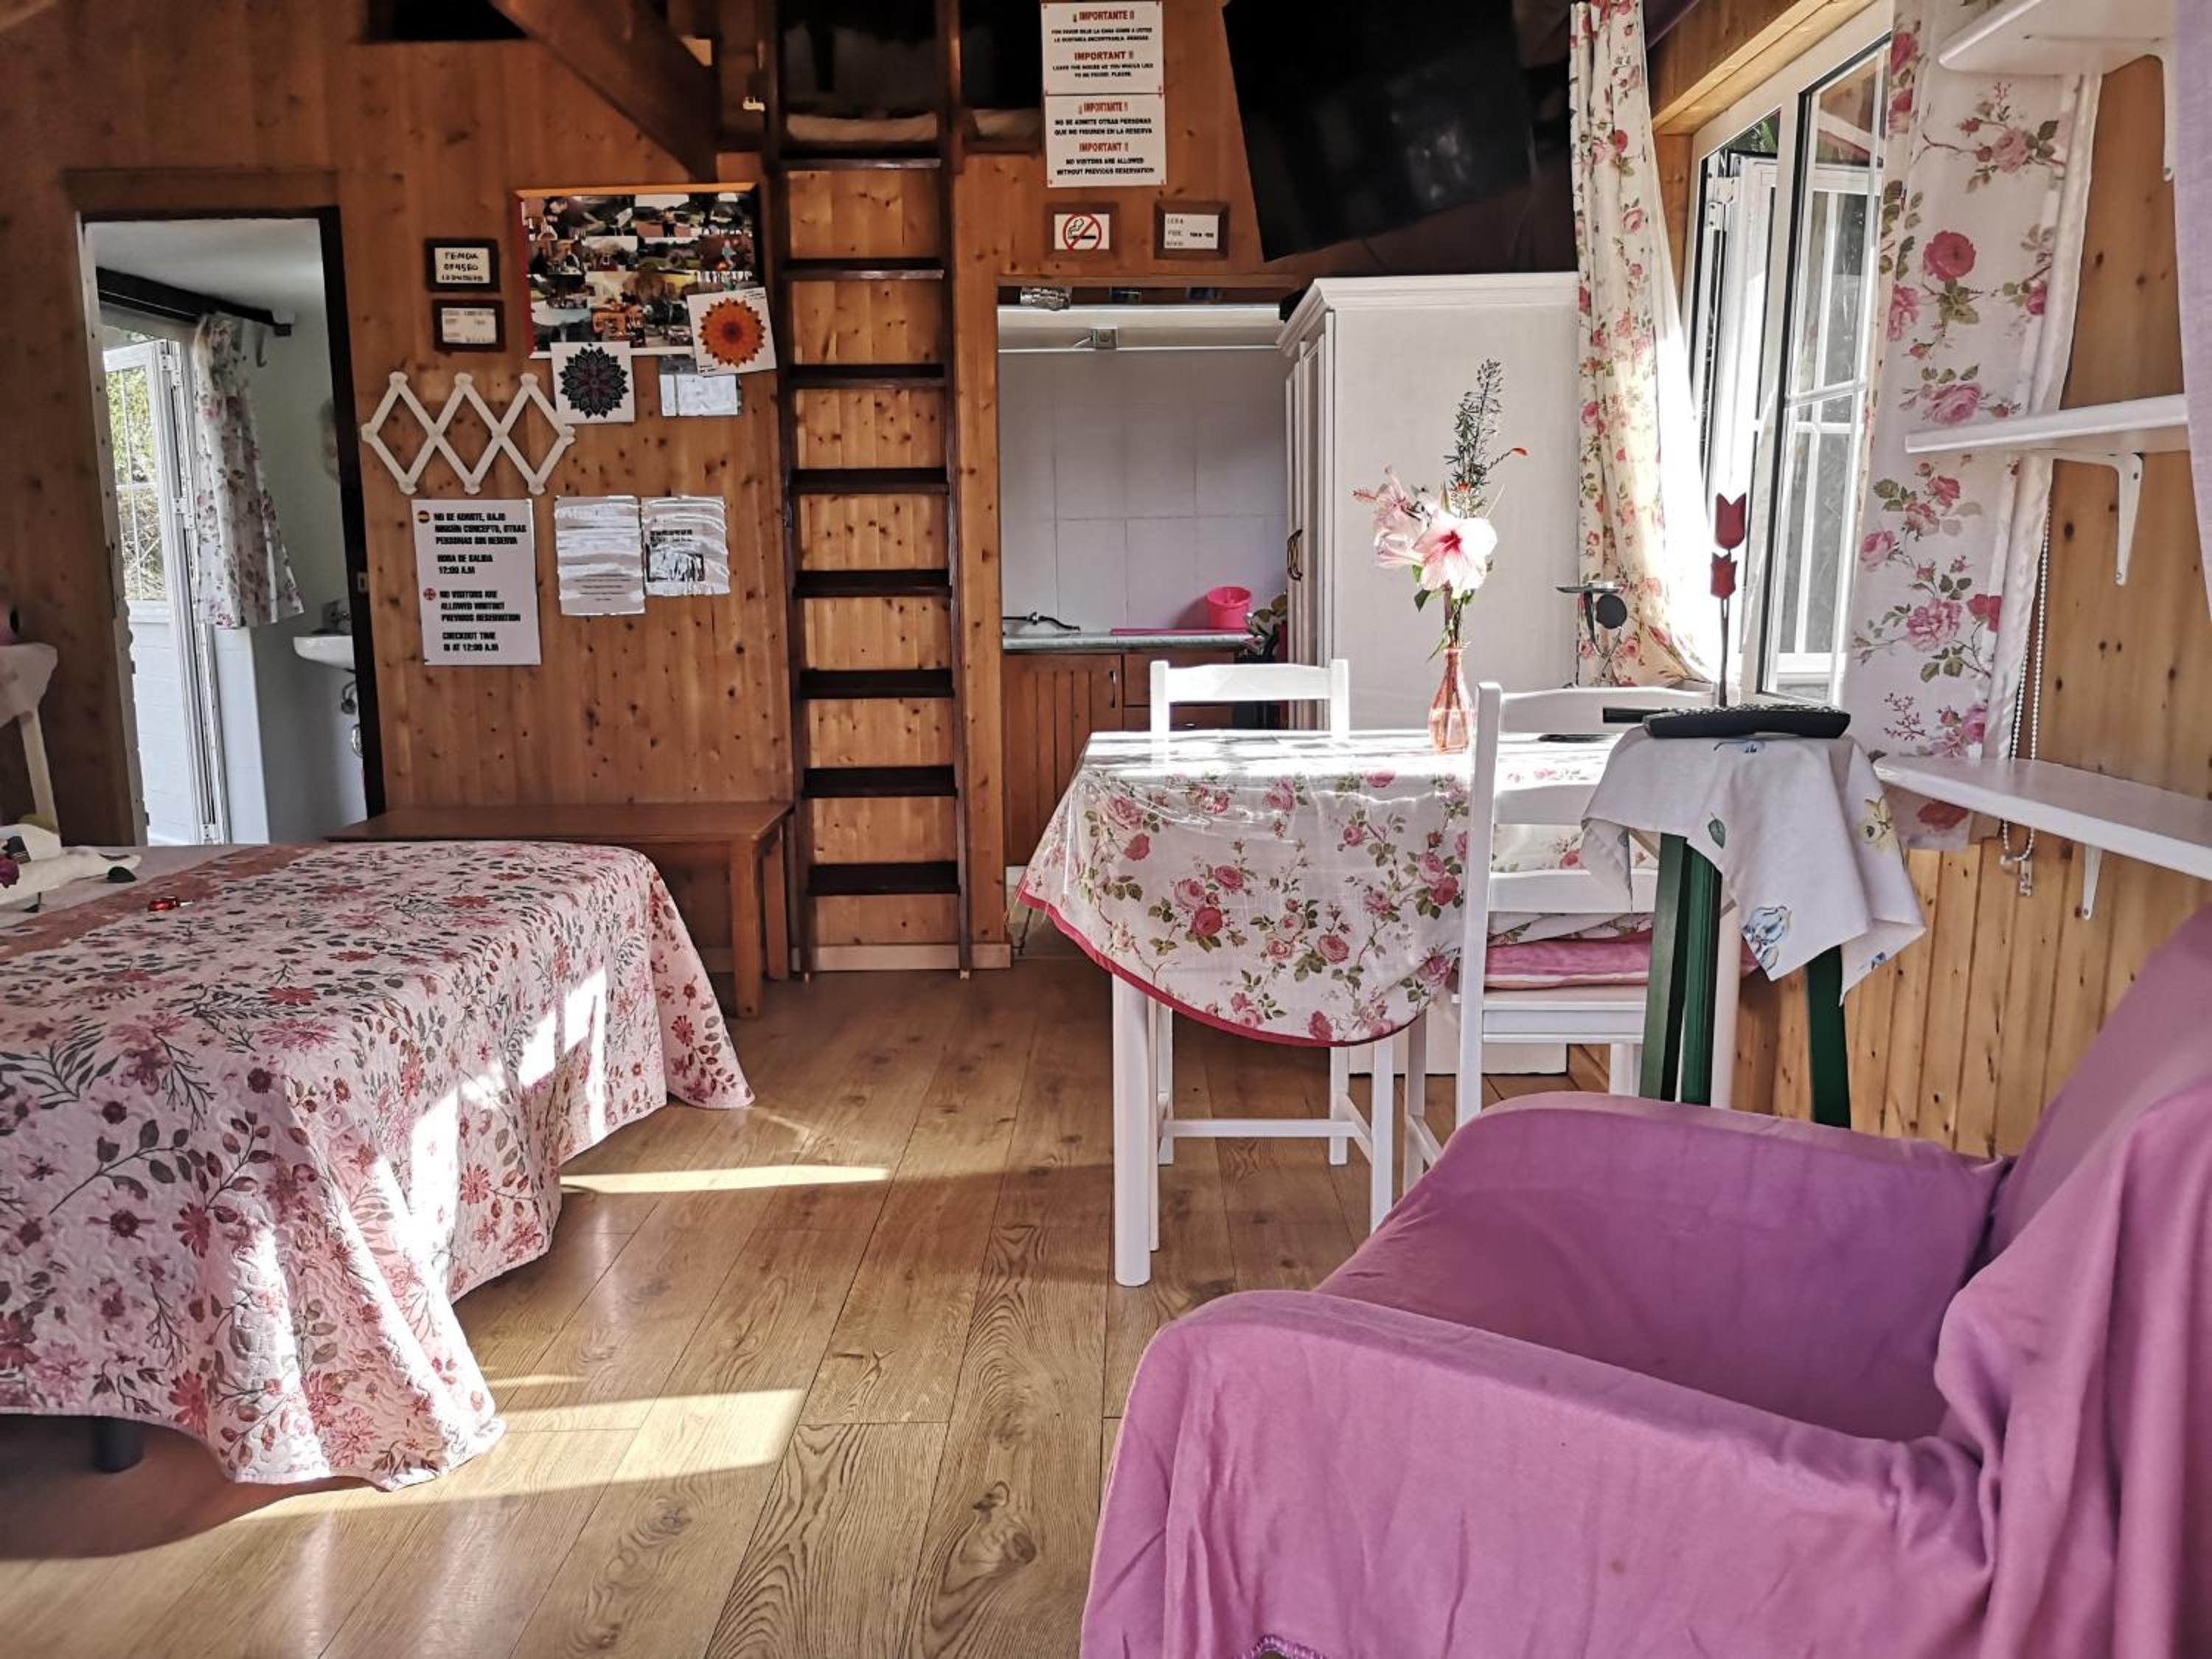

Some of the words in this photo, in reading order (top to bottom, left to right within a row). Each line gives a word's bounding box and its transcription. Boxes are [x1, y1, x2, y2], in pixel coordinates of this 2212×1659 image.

[1079, 11, 1128, 20] IMPORTANTE
[1075, 51, 1126, 60] IMPORTANT
[1084, 102, 1122, 112] IMPORTANTE
[1079, 143, 1122, 152] IMPORTANT
[463, 525, 502, 533] CONCEPTO,
